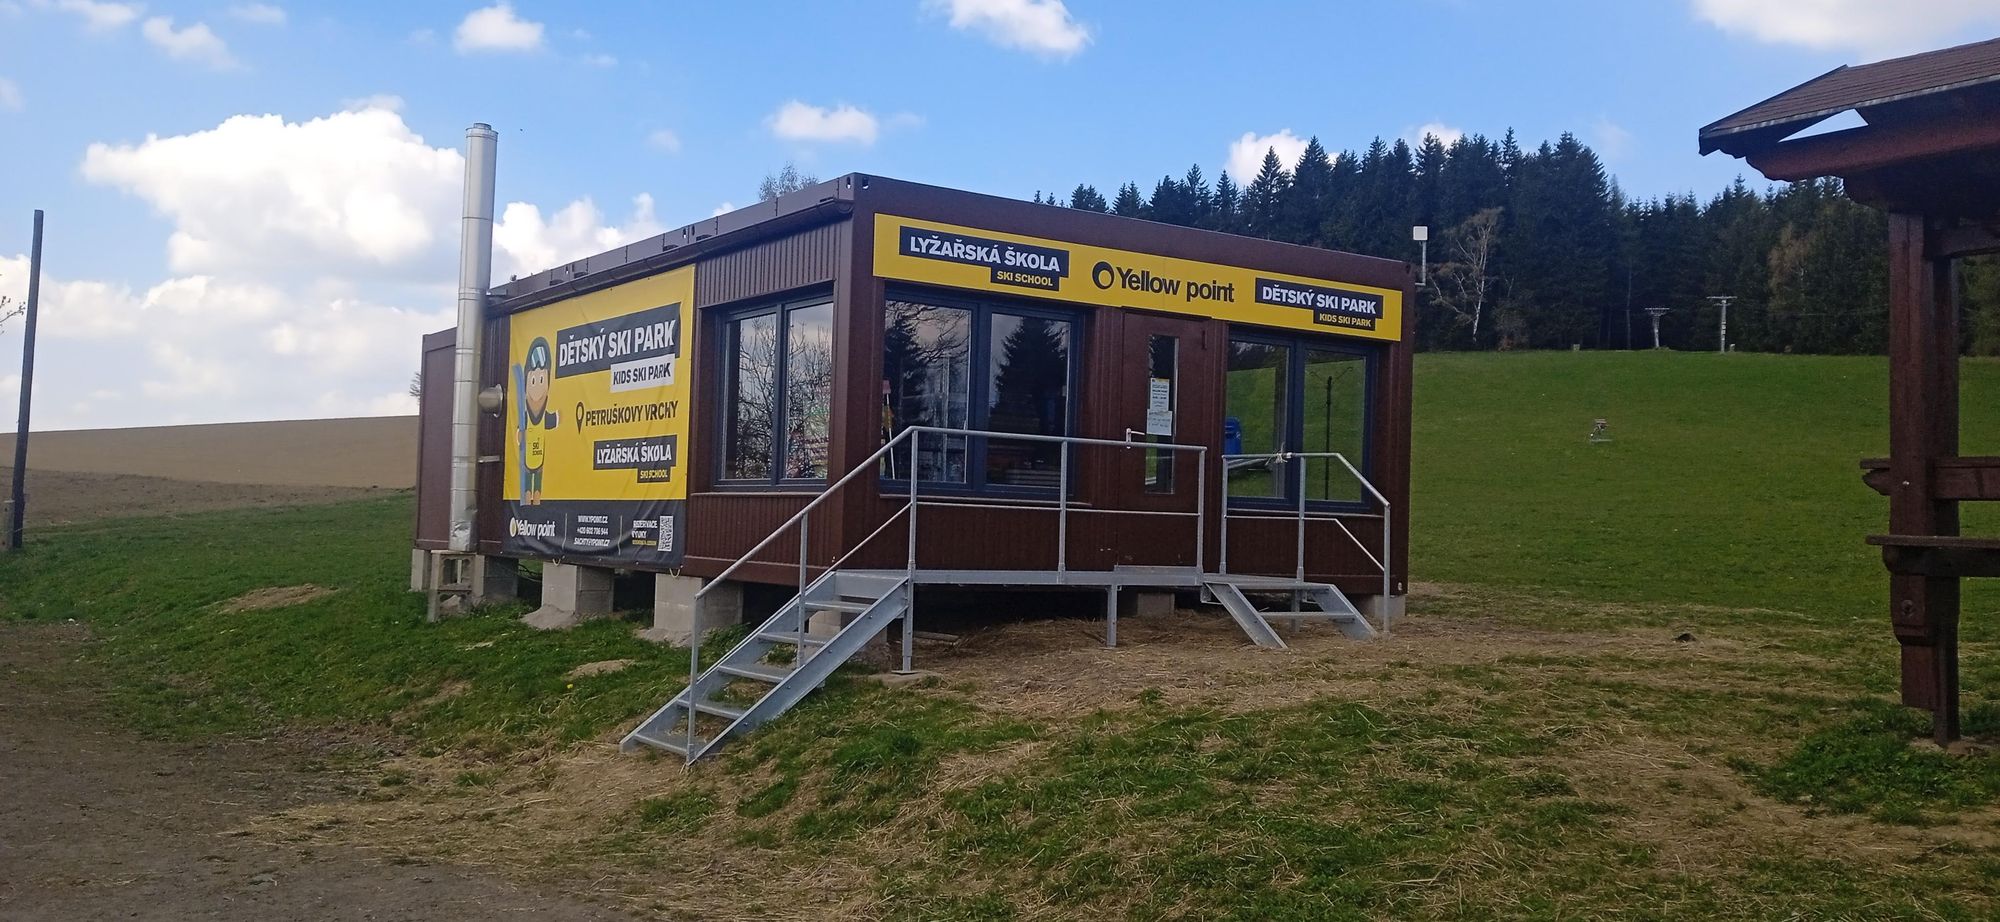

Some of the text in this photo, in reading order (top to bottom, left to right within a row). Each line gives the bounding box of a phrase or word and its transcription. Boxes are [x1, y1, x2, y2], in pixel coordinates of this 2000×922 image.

[910, 235, 1060, 272] LYŽAŘSKÁ ŠKOLA
[997, 270, 1053, 287] SKI SCHOOL
[1116, 266, 1234, 302] Yellow point
[1263, 284, 1377, 315] DĚTSKÝ SKI PARK
[1319, 313, 1372, 328] KIDS SKI PARK
[559, 320, 676, 367] DĚTSKÝ SKI PARK
[613, 362, 671, 385] KIDS SKI PARK
[585, 400, 678, 426] PETRUŠKOVY VRCHY
[597, 441, 672, 464] LYŽAŘSKÁ ŠKOLA
[640, 469, 668, 479] SKI SCHOOL
[516, 519, 556, 540] Yellow point
